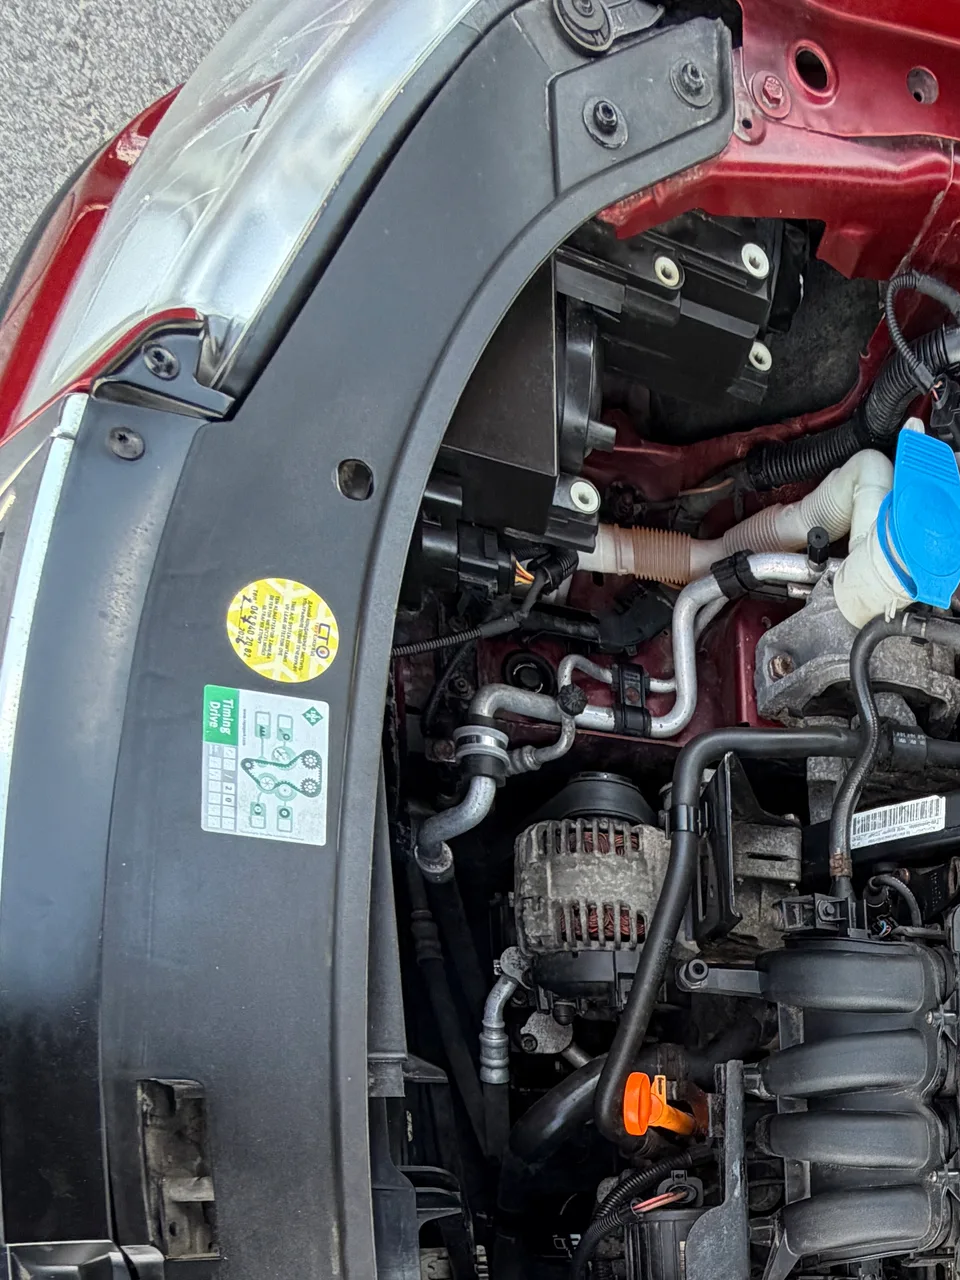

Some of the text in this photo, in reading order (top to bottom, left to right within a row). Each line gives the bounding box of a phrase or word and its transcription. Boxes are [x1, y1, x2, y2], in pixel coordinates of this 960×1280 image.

[244, 647, 252, 658] 82
[209, 701, 220, 728] Drive
[221, 699, 233, 735] Timing
